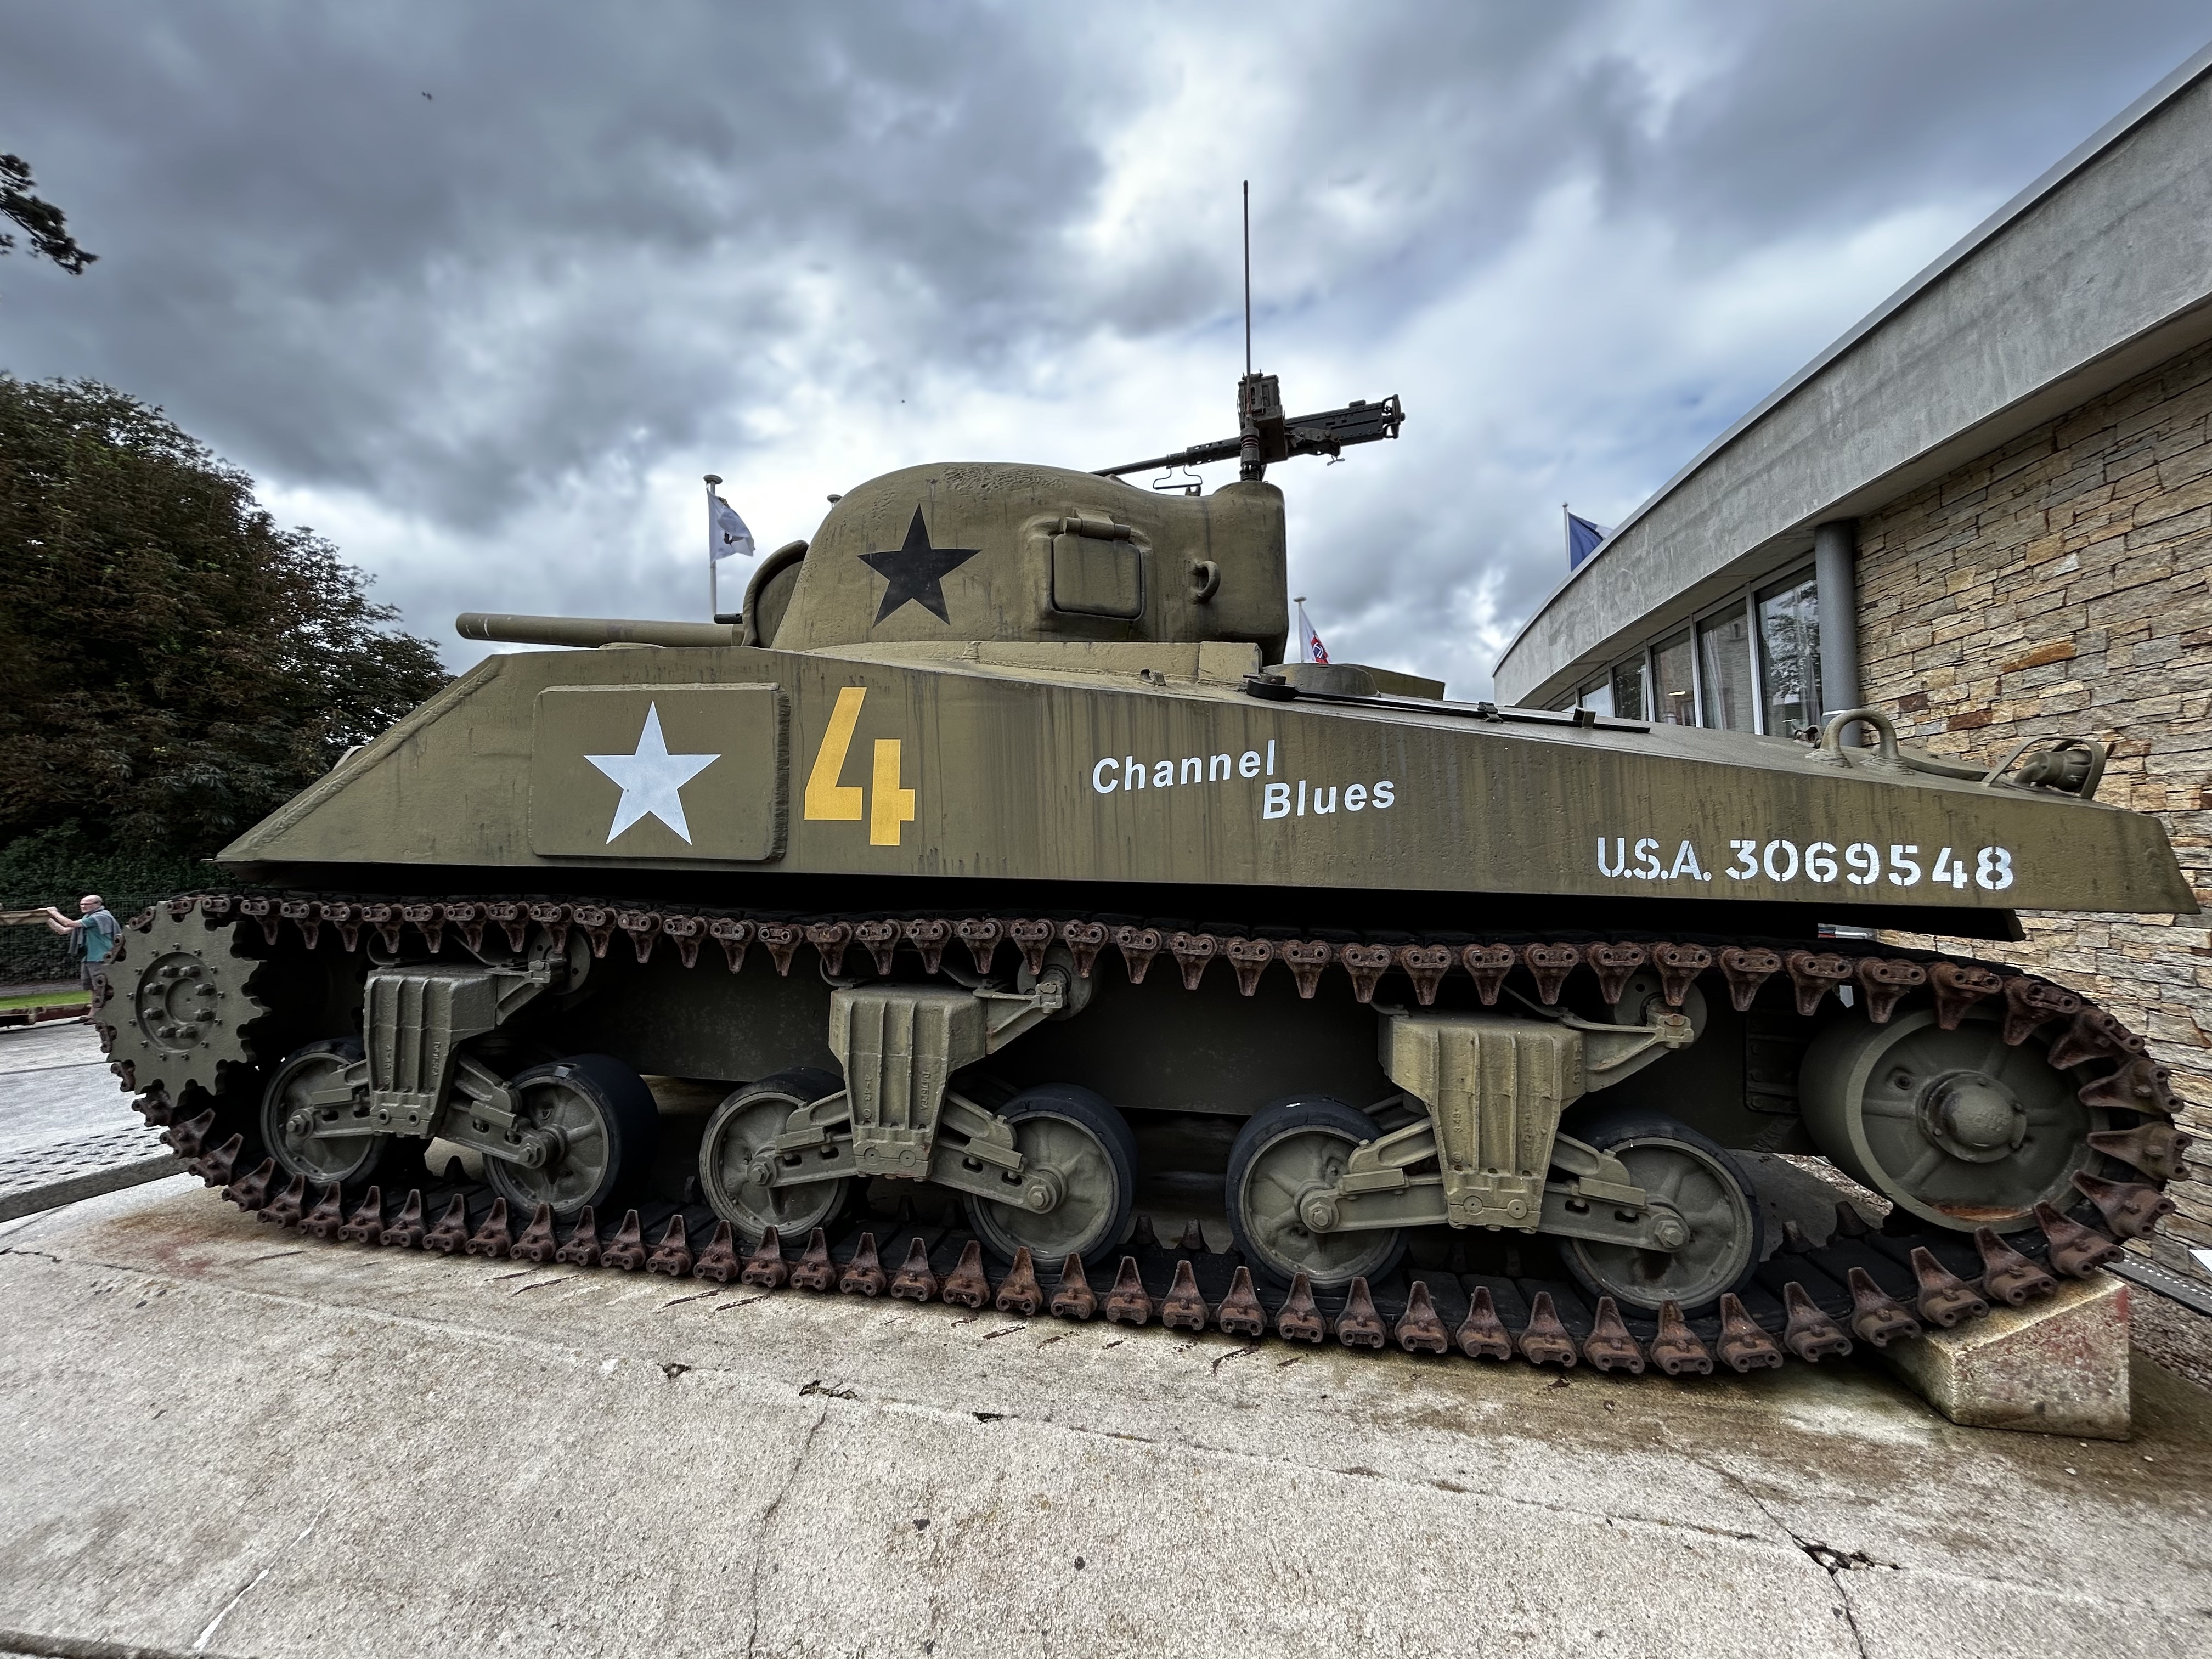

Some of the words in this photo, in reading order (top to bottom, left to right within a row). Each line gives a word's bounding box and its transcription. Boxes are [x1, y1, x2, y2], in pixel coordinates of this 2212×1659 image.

[804, 687, 915, 845] 4
[1093, 740, 1275, 793] Channel
[1263, 780, 1395, 819] Blues
[1598, 837, 1712, 881] U.S.A.
[1725, 840, 2013, 890] 3069548
